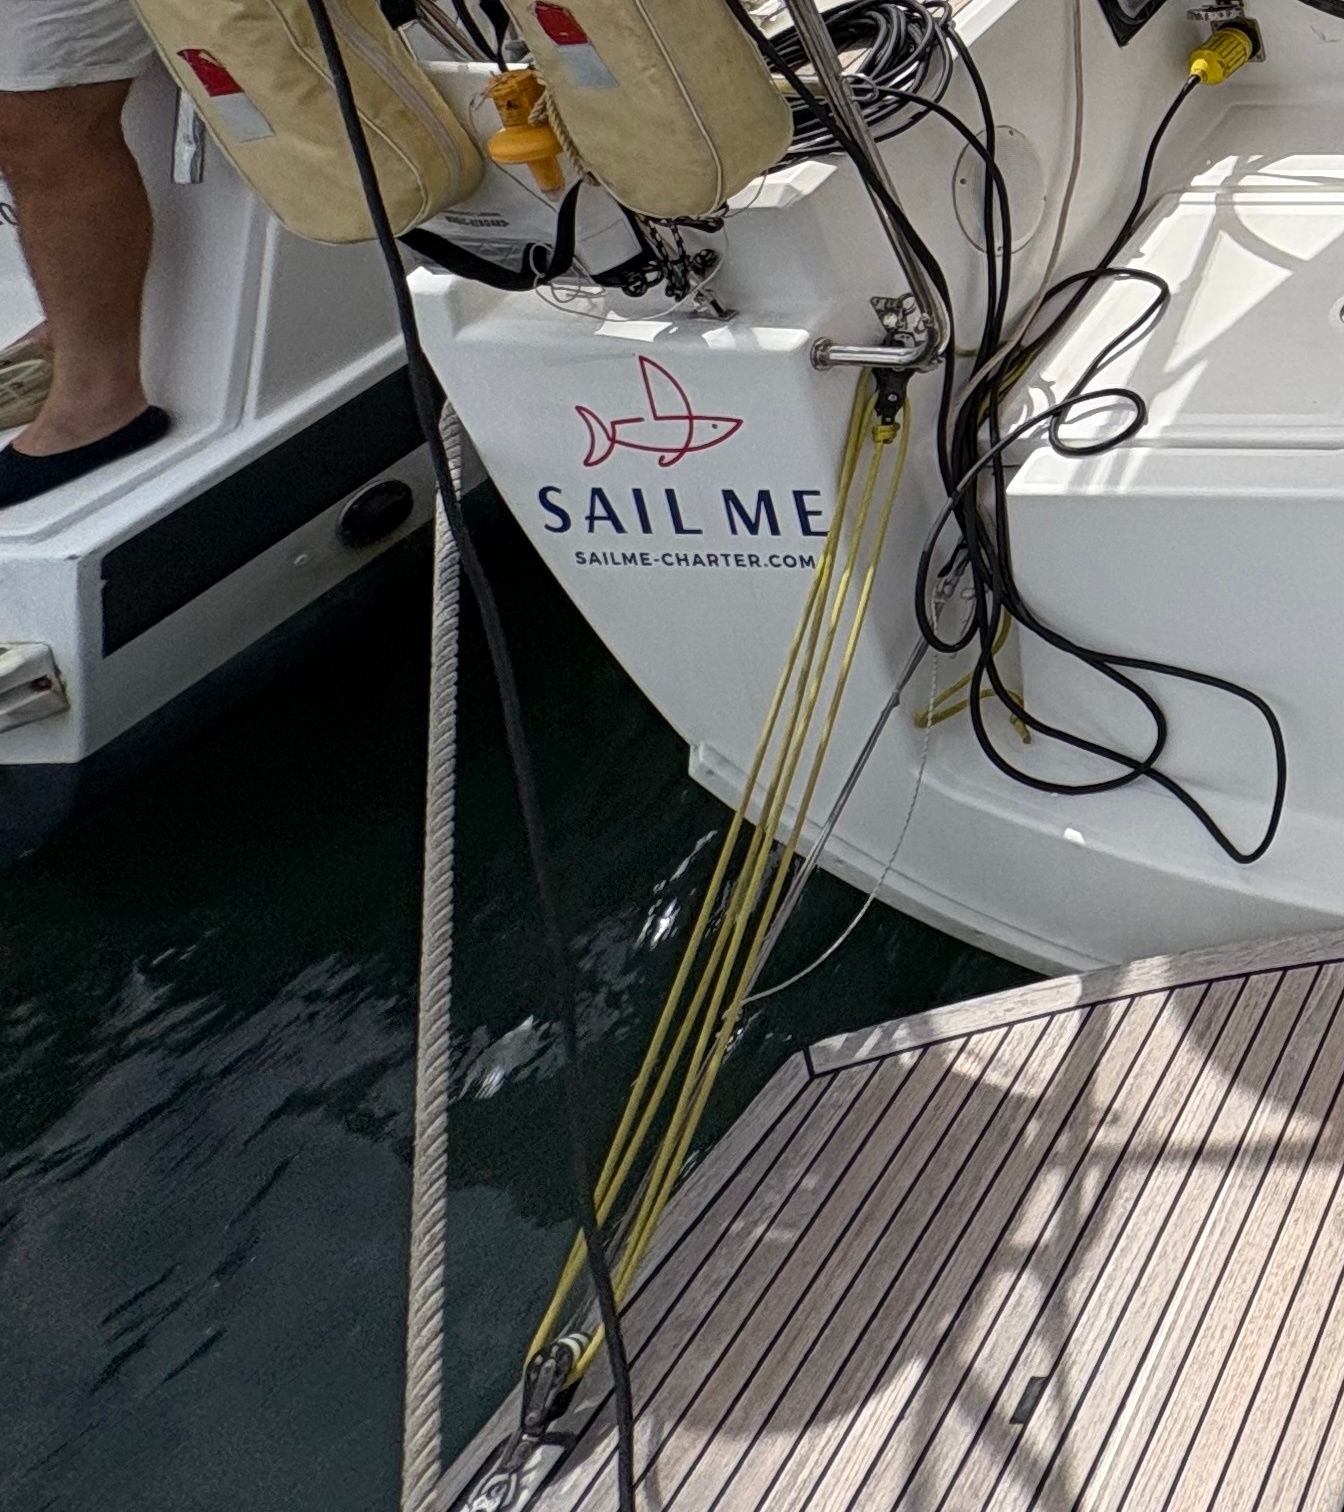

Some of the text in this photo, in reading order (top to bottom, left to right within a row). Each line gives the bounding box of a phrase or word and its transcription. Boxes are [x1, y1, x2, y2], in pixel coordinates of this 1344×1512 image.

[538, 486, 830, 537] SAIL ME
[575, 551, 816, 569] SAILME-CHARTER.COM
